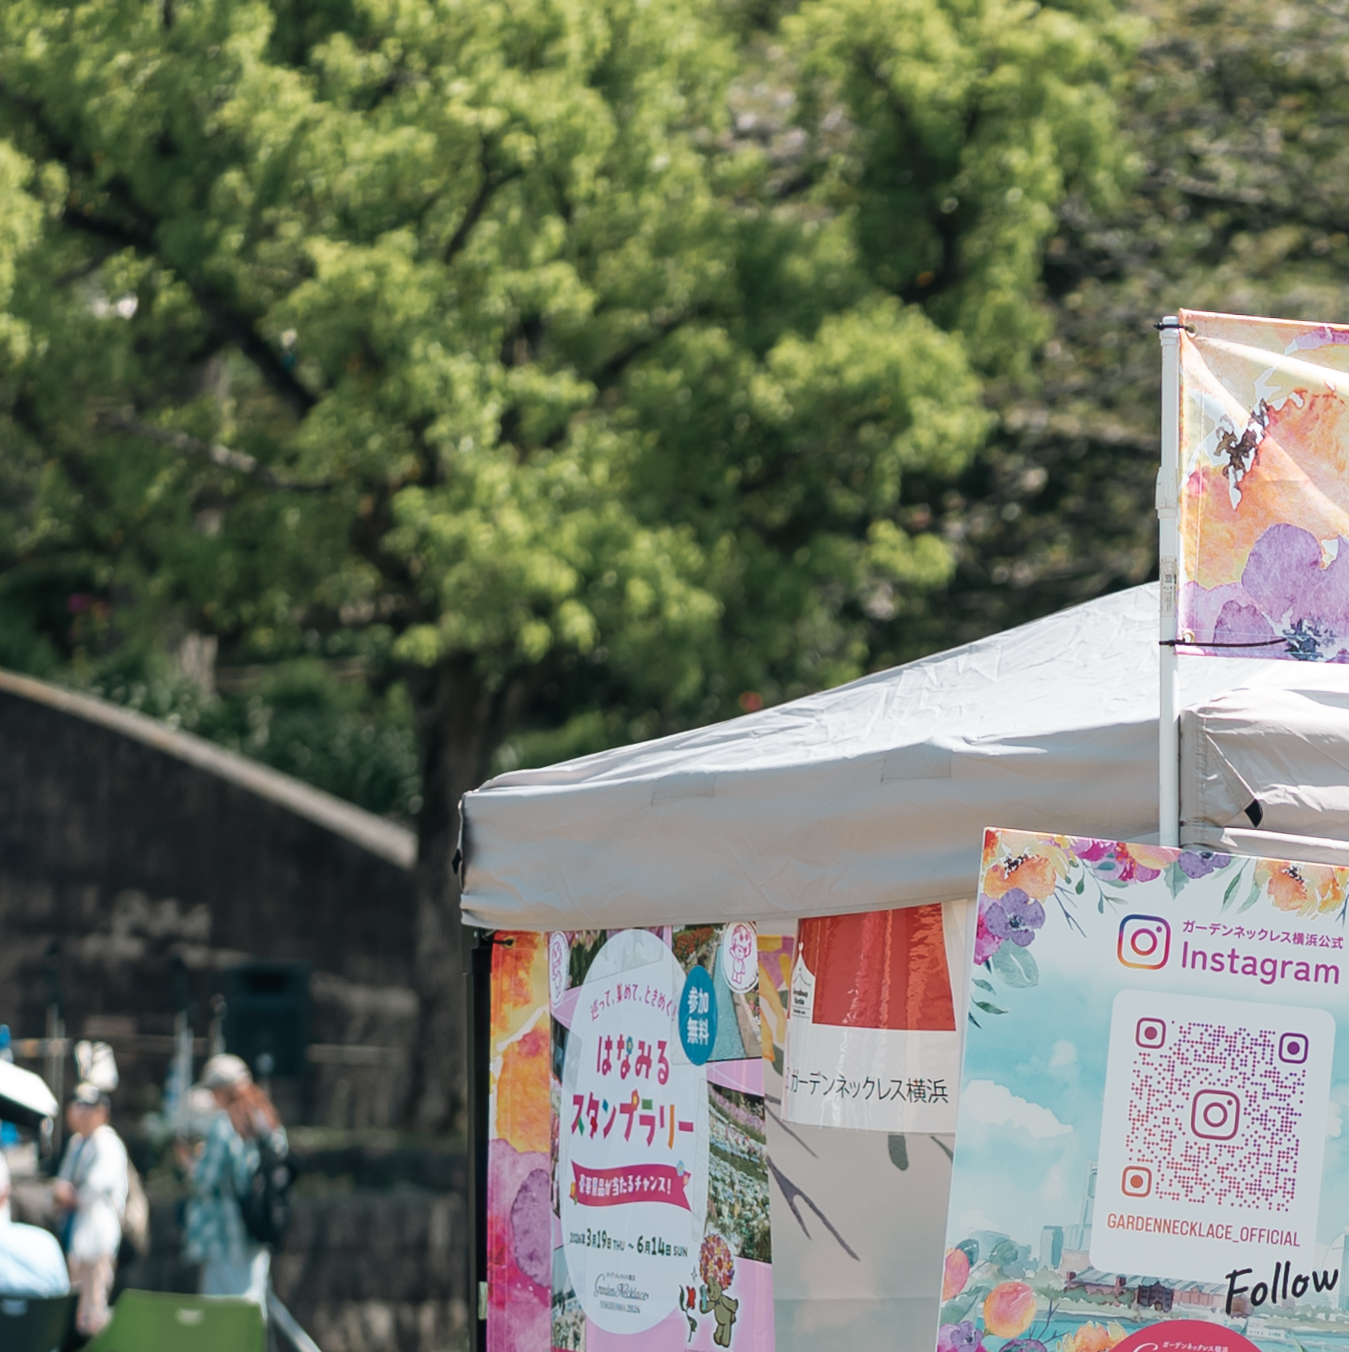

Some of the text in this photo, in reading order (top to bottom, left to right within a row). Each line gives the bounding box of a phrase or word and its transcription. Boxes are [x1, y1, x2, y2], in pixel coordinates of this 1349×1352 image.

[1182, 919, 1344, 950] ガーデンネックレス横浜公式
[1181, 941, 1341, 985] Instagram
[687, 986, 710, 1014] 参加
[596, 1034, 670, 1086] はなみる
[791, 1069, 949, 1104] ガーデンネックレス横浜
[571, 1089, 694, 1151] スタンプラリー
[1107, 1212, 1301, 1248] GARDENNECKLACE_OFFICIAL
[1224, 1260, 1339, 1316] Follow
